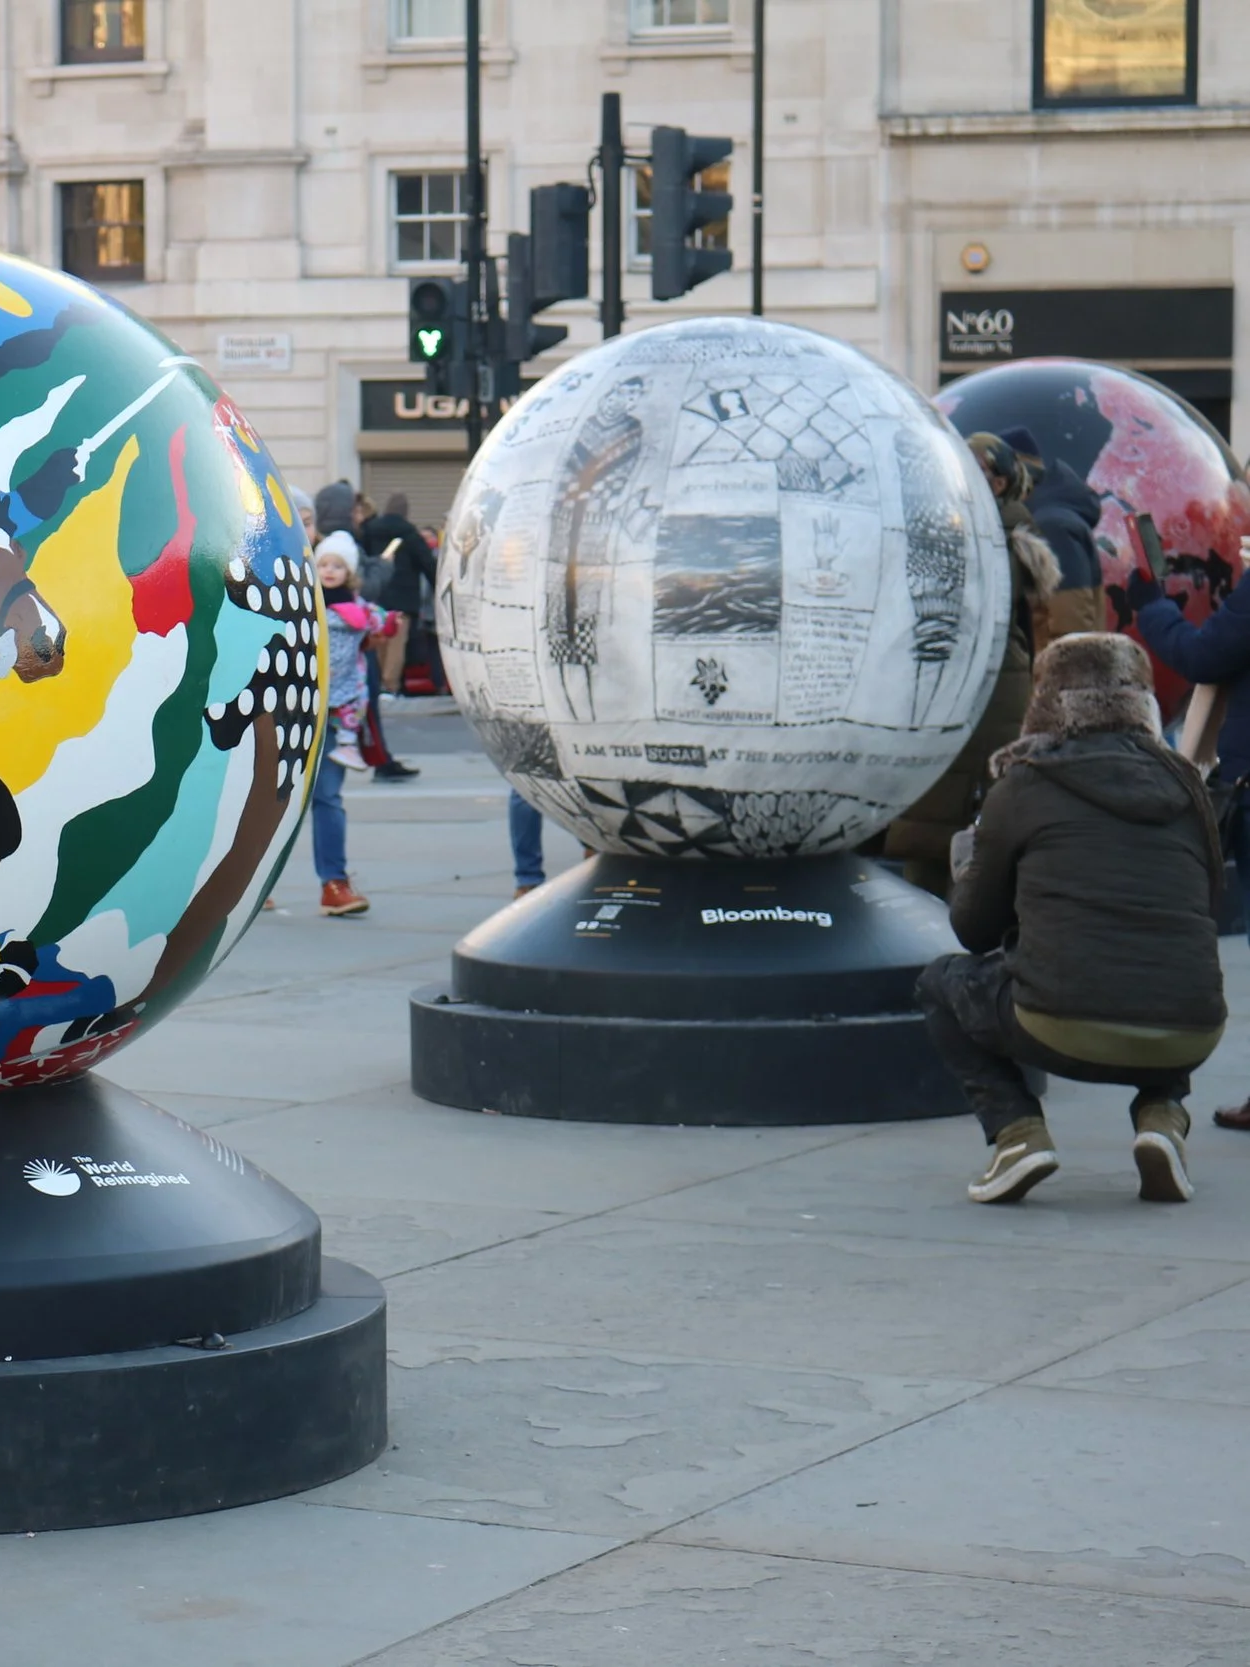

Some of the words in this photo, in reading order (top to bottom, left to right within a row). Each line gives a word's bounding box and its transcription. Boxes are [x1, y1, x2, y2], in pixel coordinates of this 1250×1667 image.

[572, 743, 580, 755] I
[584, 744, 607, 756] AM
[610, 744, 642, 758] THE
[646, 745, 705, 765] SUGAR
[709, 748, 730, 761] AT
[735, 750, 769, 763] THE
[771, 750, 841, 764] BOTTOM
[701, 906, 832, 927] Bloomberg
[72, 1155, 93, 1164] The
[80, 1161, 136, 1176] World
[91, 1172, 191, 1188] Reimagined
